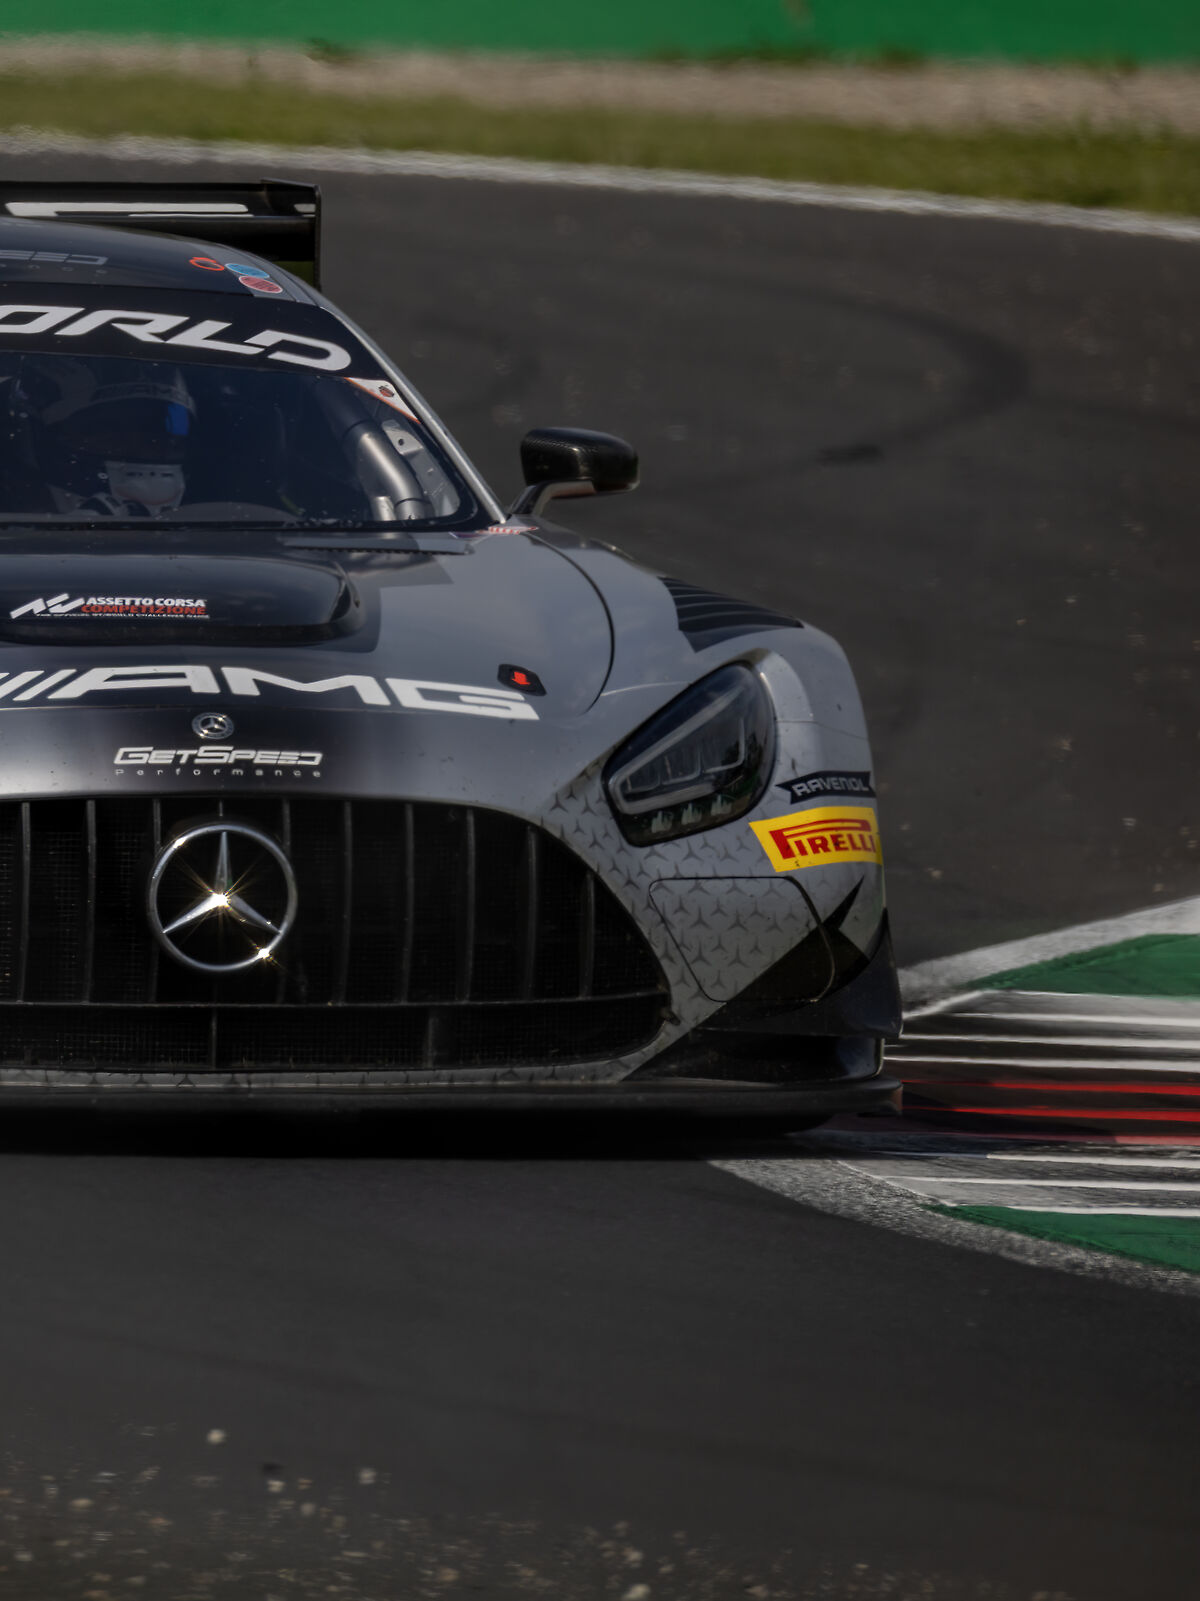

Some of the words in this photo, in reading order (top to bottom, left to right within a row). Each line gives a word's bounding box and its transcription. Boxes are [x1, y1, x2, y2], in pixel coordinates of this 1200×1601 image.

[81, 605, 206, 615] COMPETIZIONE
[86, 597, 153, 607] ASSETTO
[155, 598, 206, 608] CORSA
[47, 664, 540, 721] AMG
[791, 777, 870, 797] RAVENOL
[768, 818, 878, 860] PIRELLI
